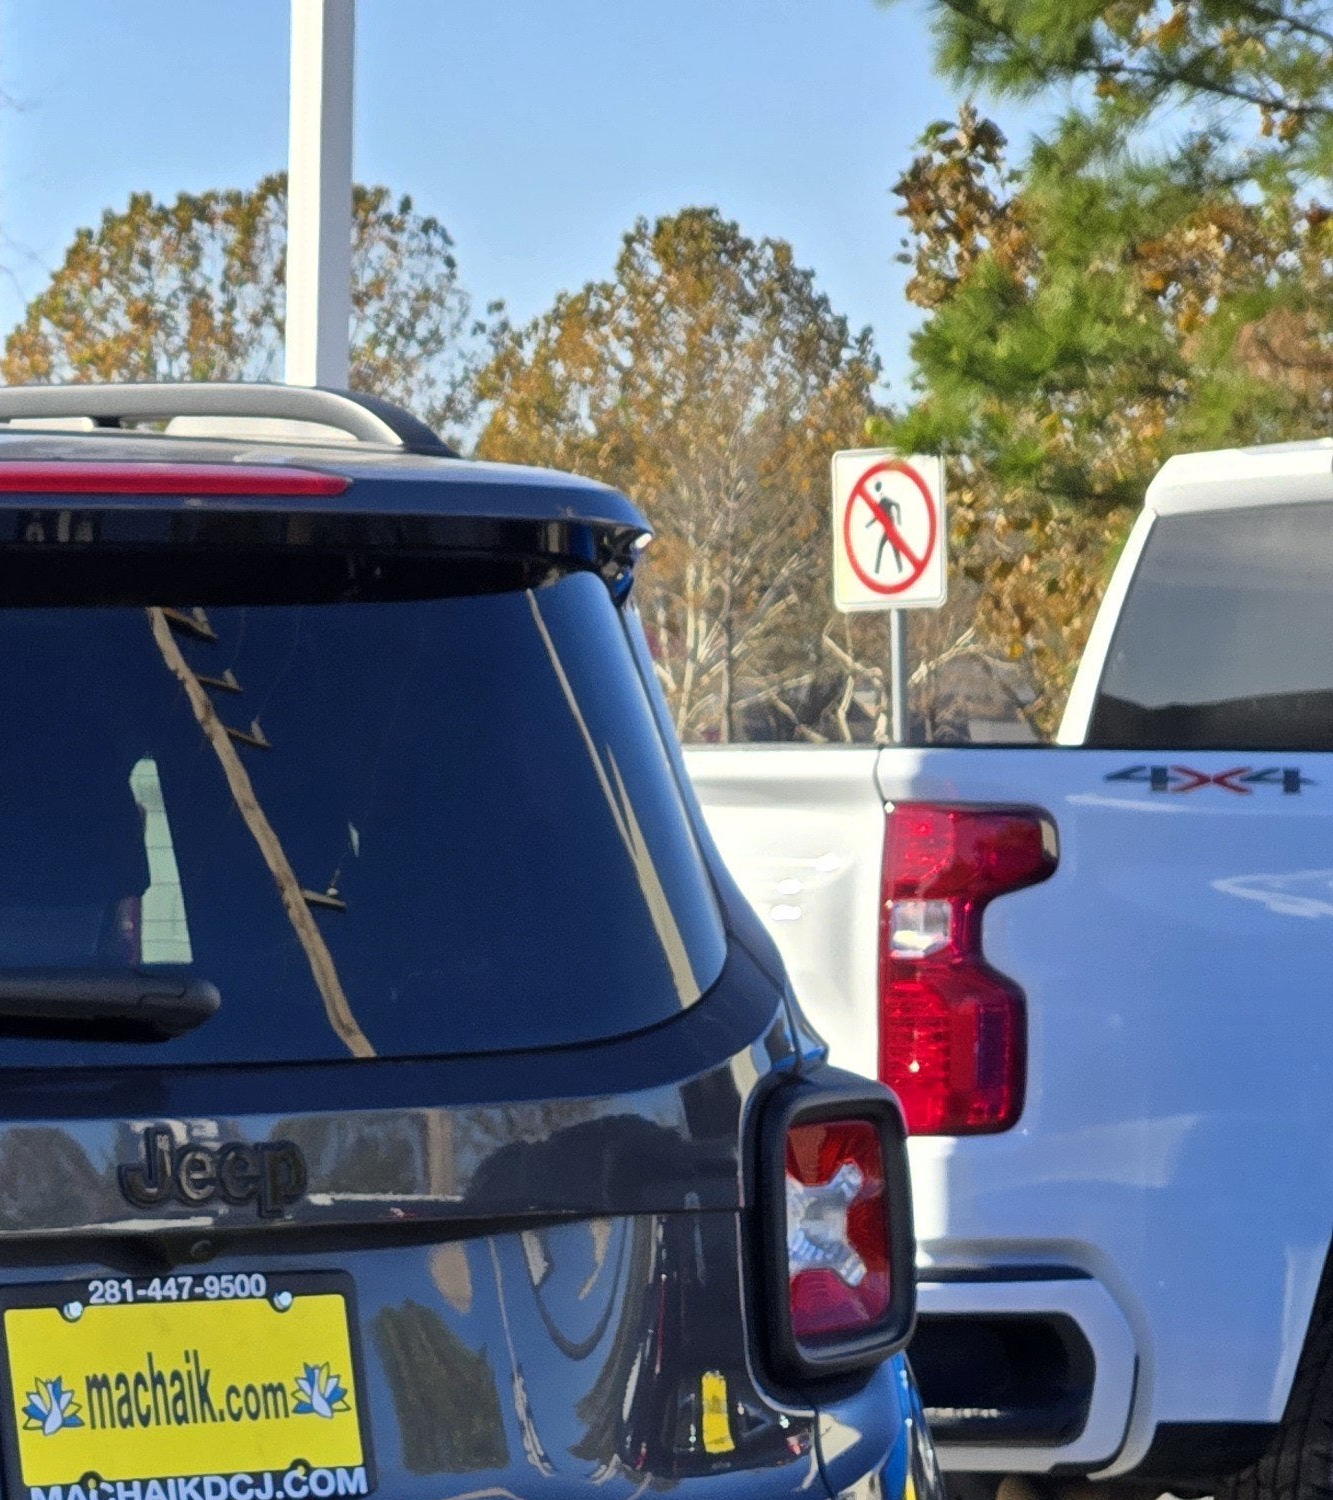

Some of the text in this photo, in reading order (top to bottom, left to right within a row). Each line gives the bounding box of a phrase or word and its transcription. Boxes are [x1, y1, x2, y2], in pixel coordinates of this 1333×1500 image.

[117, 1126, 308, 1219] Jeep
[87, 1273, 267, 1305] 281-447-9500
[84, 1348, 291, 1430] machaik.com
